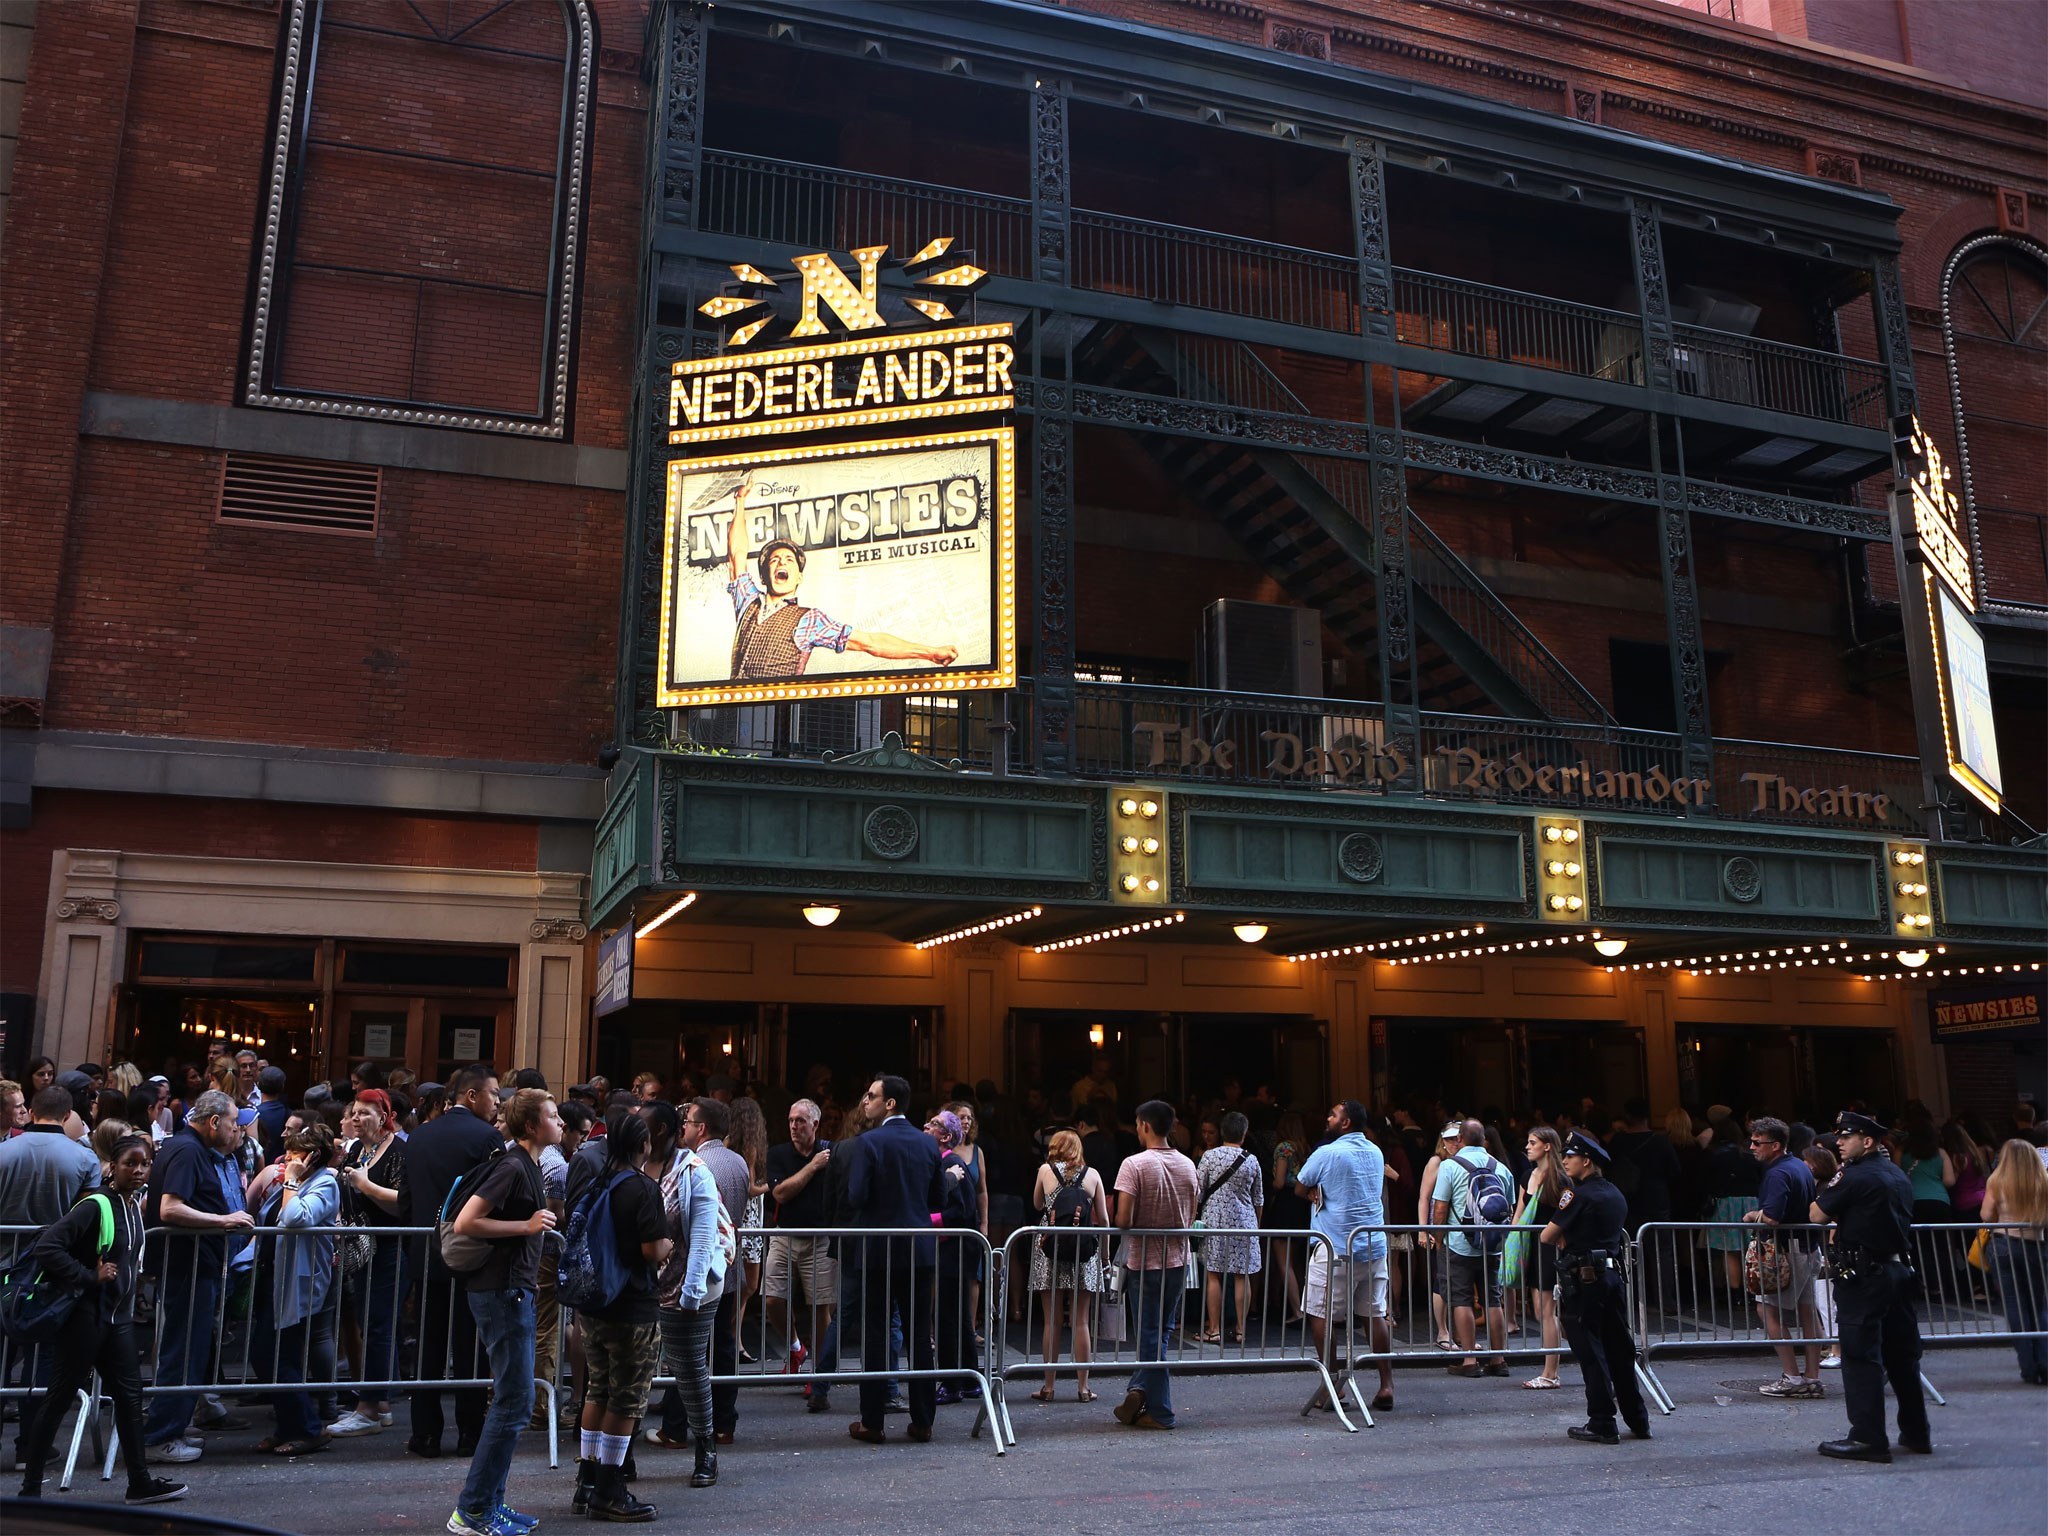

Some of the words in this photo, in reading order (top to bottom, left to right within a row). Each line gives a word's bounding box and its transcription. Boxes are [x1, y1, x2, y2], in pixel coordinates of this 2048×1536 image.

[789, 245, 888, 338] N
[669, 343, 1015, 427] NEDERLANDER
[690, 478, 978, 561] NEWSIES
[844, 548, 882, 565] THE
[888, 536, 976, 559] MUSICAL
[1132, 721, 1237, 771] The
[1260, 729, 1408, 782] David
[1436, 745, 1712, 807] Nederlander
[1740, 772, 1889, 821] Theatre
[1935, 995, 2039, 1025] NEWSIES
